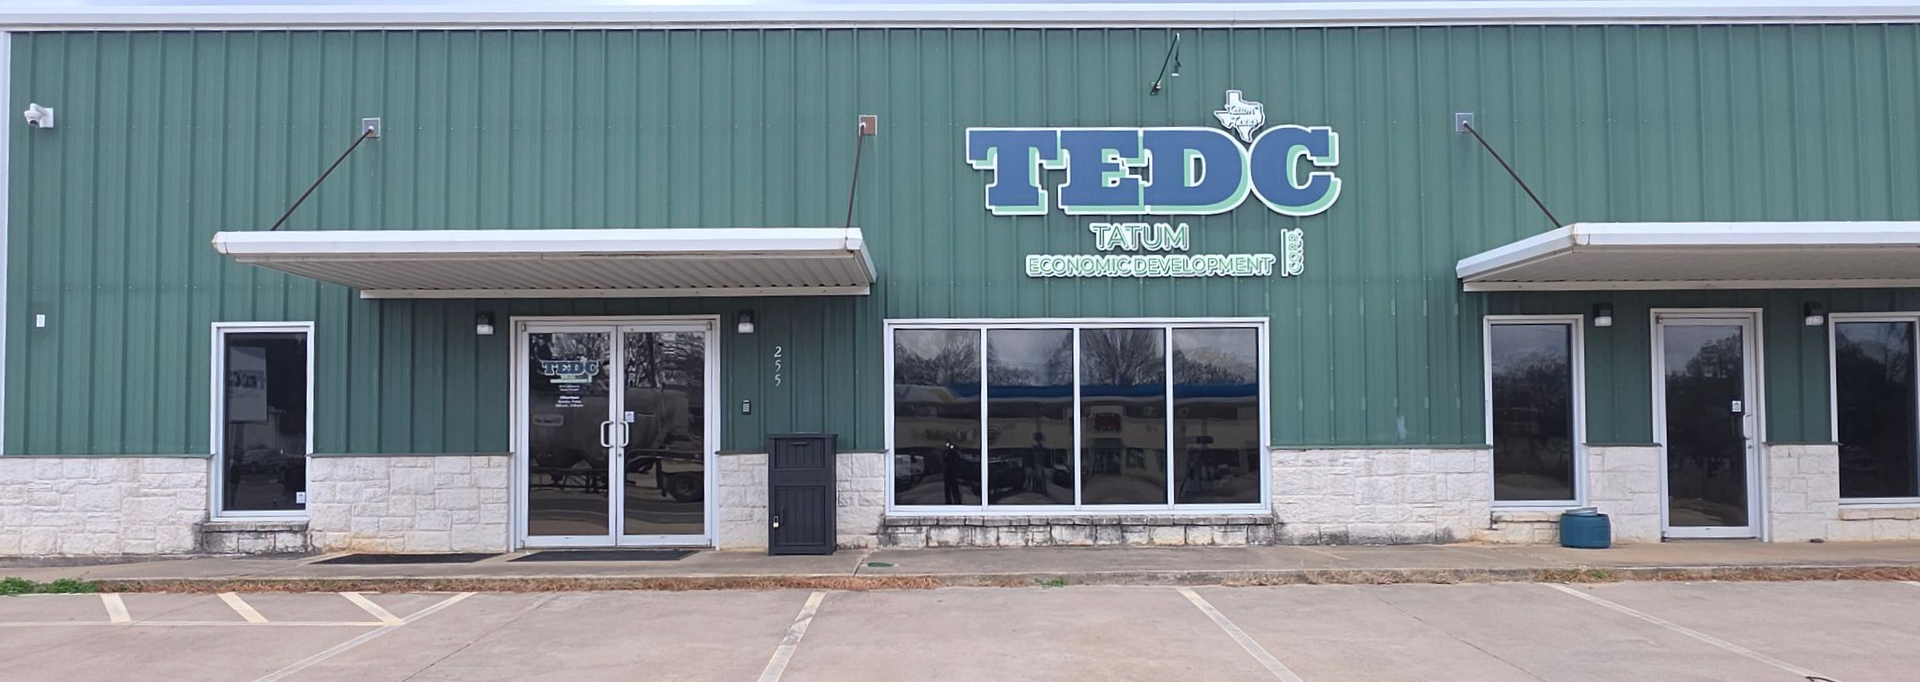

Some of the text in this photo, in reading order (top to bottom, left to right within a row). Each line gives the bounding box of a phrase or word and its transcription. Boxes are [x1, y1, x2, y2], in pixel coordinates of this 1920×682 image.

[966, 125, 1341, 216] TEDC
[1090, 223, 1189, 251] TATUM
[1026, 255, 1275, 278] ECONOMIC DEVELOPMENT
[542, 360, 599, 376] TEDC
[773, 345, 782, 387] 255
